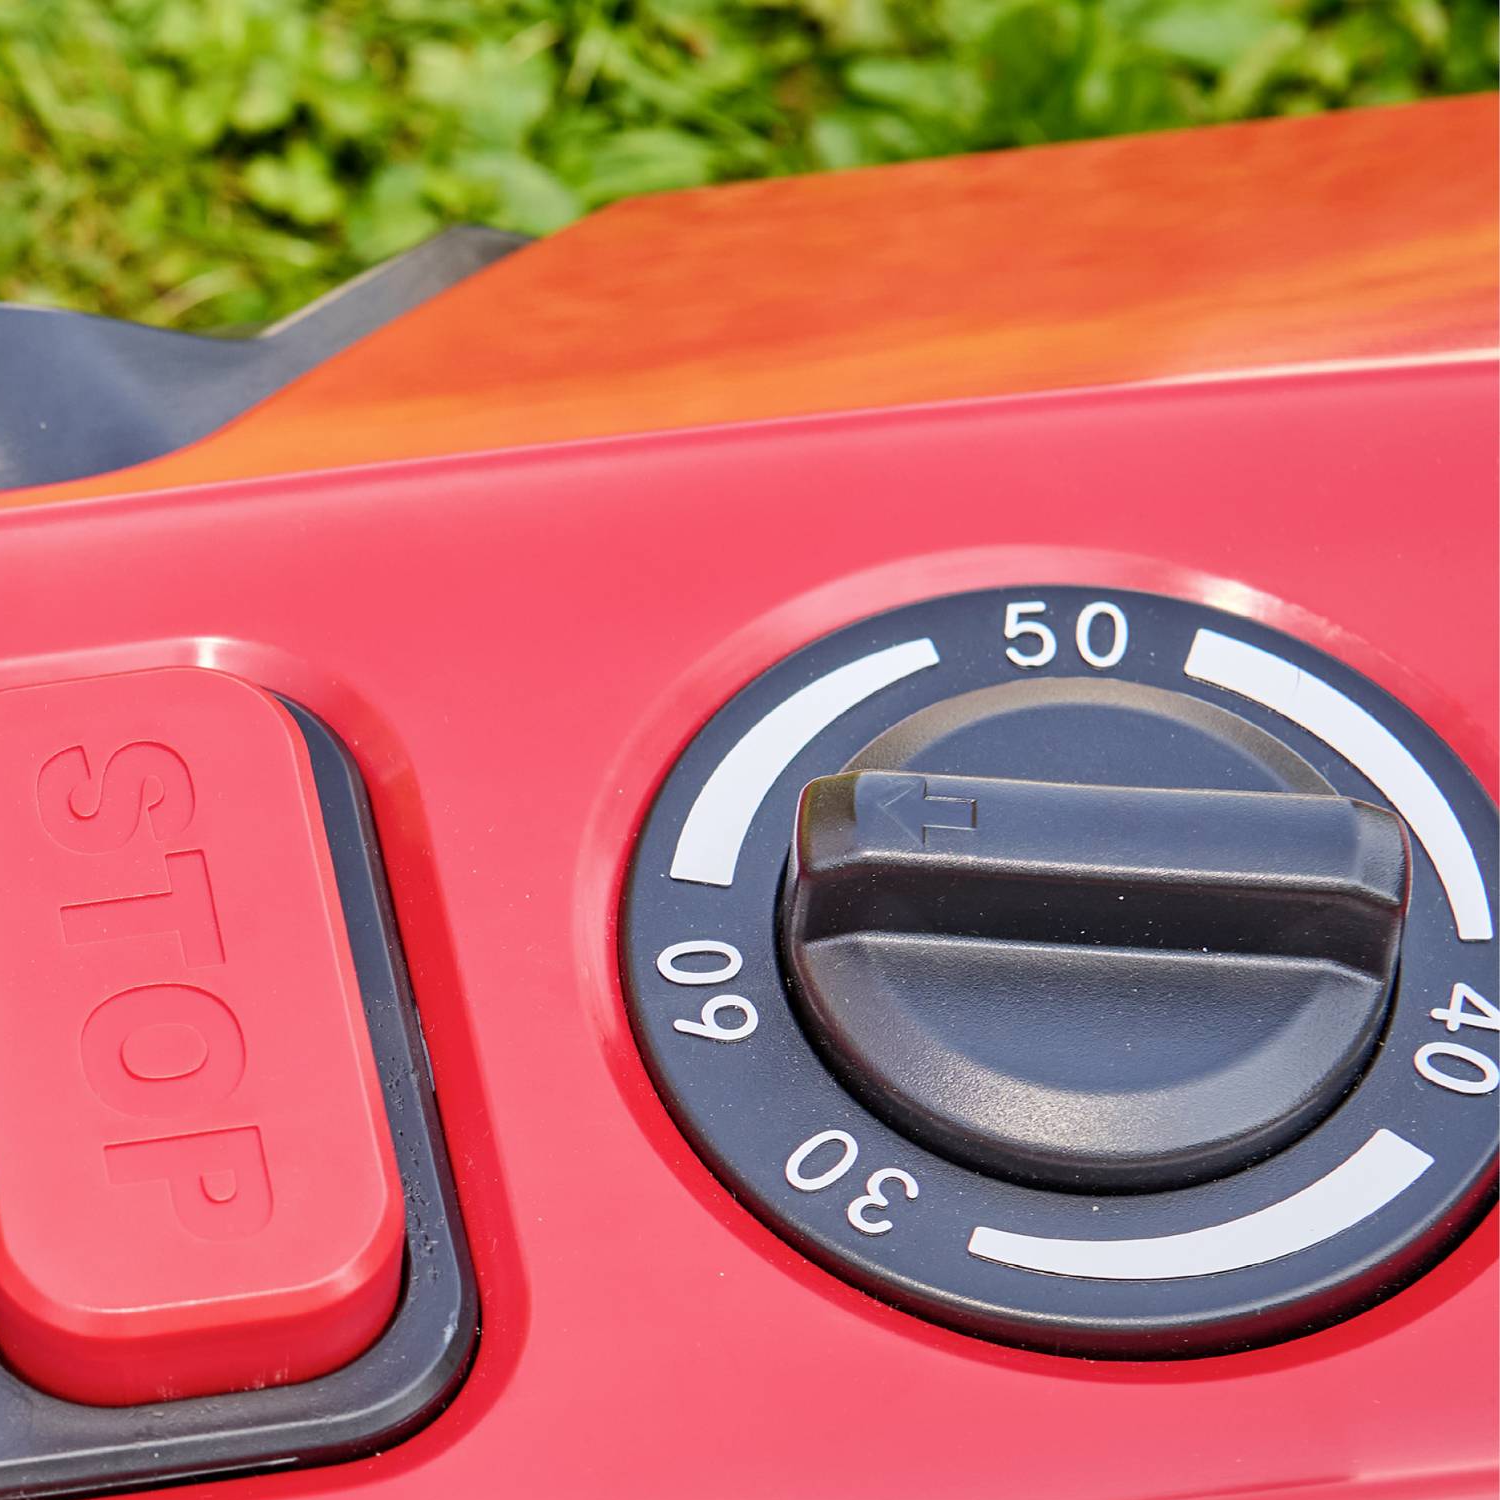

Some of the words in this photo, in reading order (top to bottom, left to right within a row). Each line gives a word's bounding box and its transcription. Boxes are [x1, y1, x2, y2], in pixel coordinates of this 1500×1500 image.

[1002, 600, 1130, 669] 50
[36, 739, 275, 1243] STOP
[655, 939, 760, 1043] 60
[1412, 981, 1500, 1097] 40
[784, 1128, 921, 1235] 30
